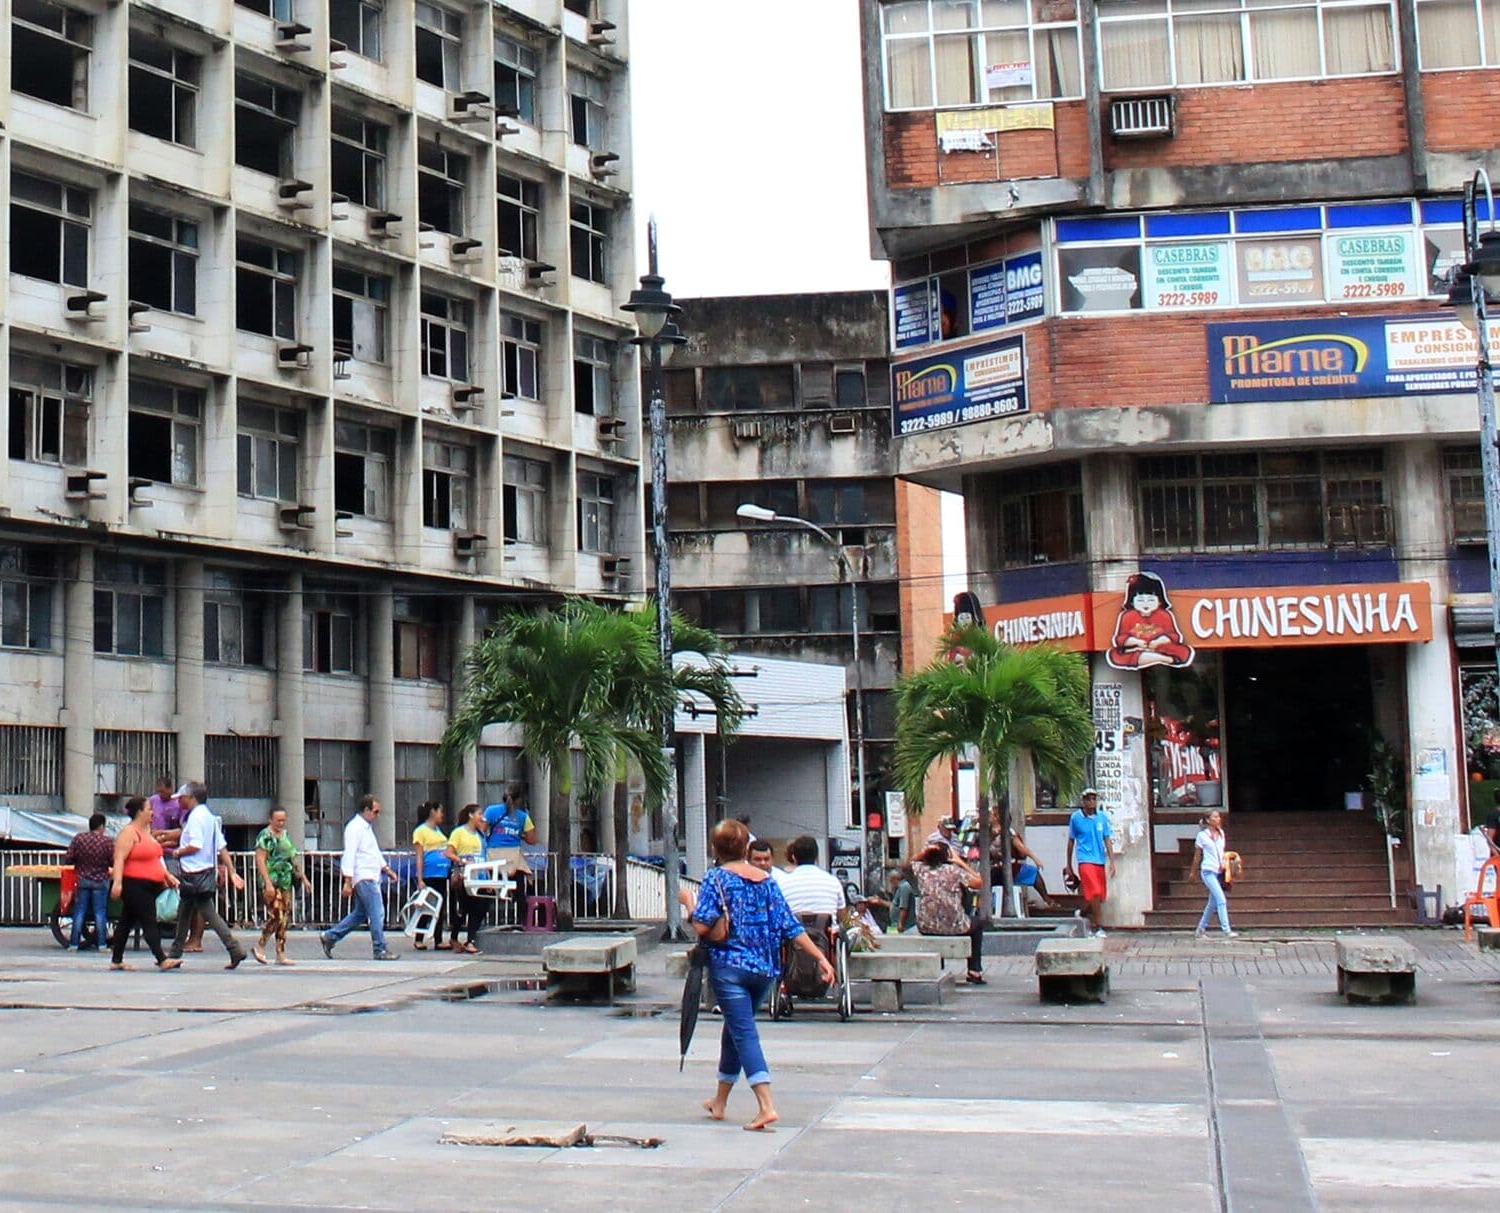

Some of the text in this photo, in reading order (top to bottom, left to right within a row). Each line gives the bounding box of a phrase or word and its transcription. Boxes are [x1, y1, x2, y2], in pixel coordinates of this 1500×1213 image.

[1339, 237, 1401, 254] CASEBRAS
[1155, 247, 1217, 264] CASEBRAS
[1007, 263, 1042, 291] BMG
[1157, 291, 1218, 306] 3222-5989
[1343, 282, 1405, 298] 3222-5989
[1230, 376, 1297, 389] PROMOTORA
[1297, 375, 1311, 386] DE
[900, 411, 954, 434] 3222-5989
[1190, 592, 1419, 640] CHINESINHA
[994, 610, 1086, 645] CHINESINHA
